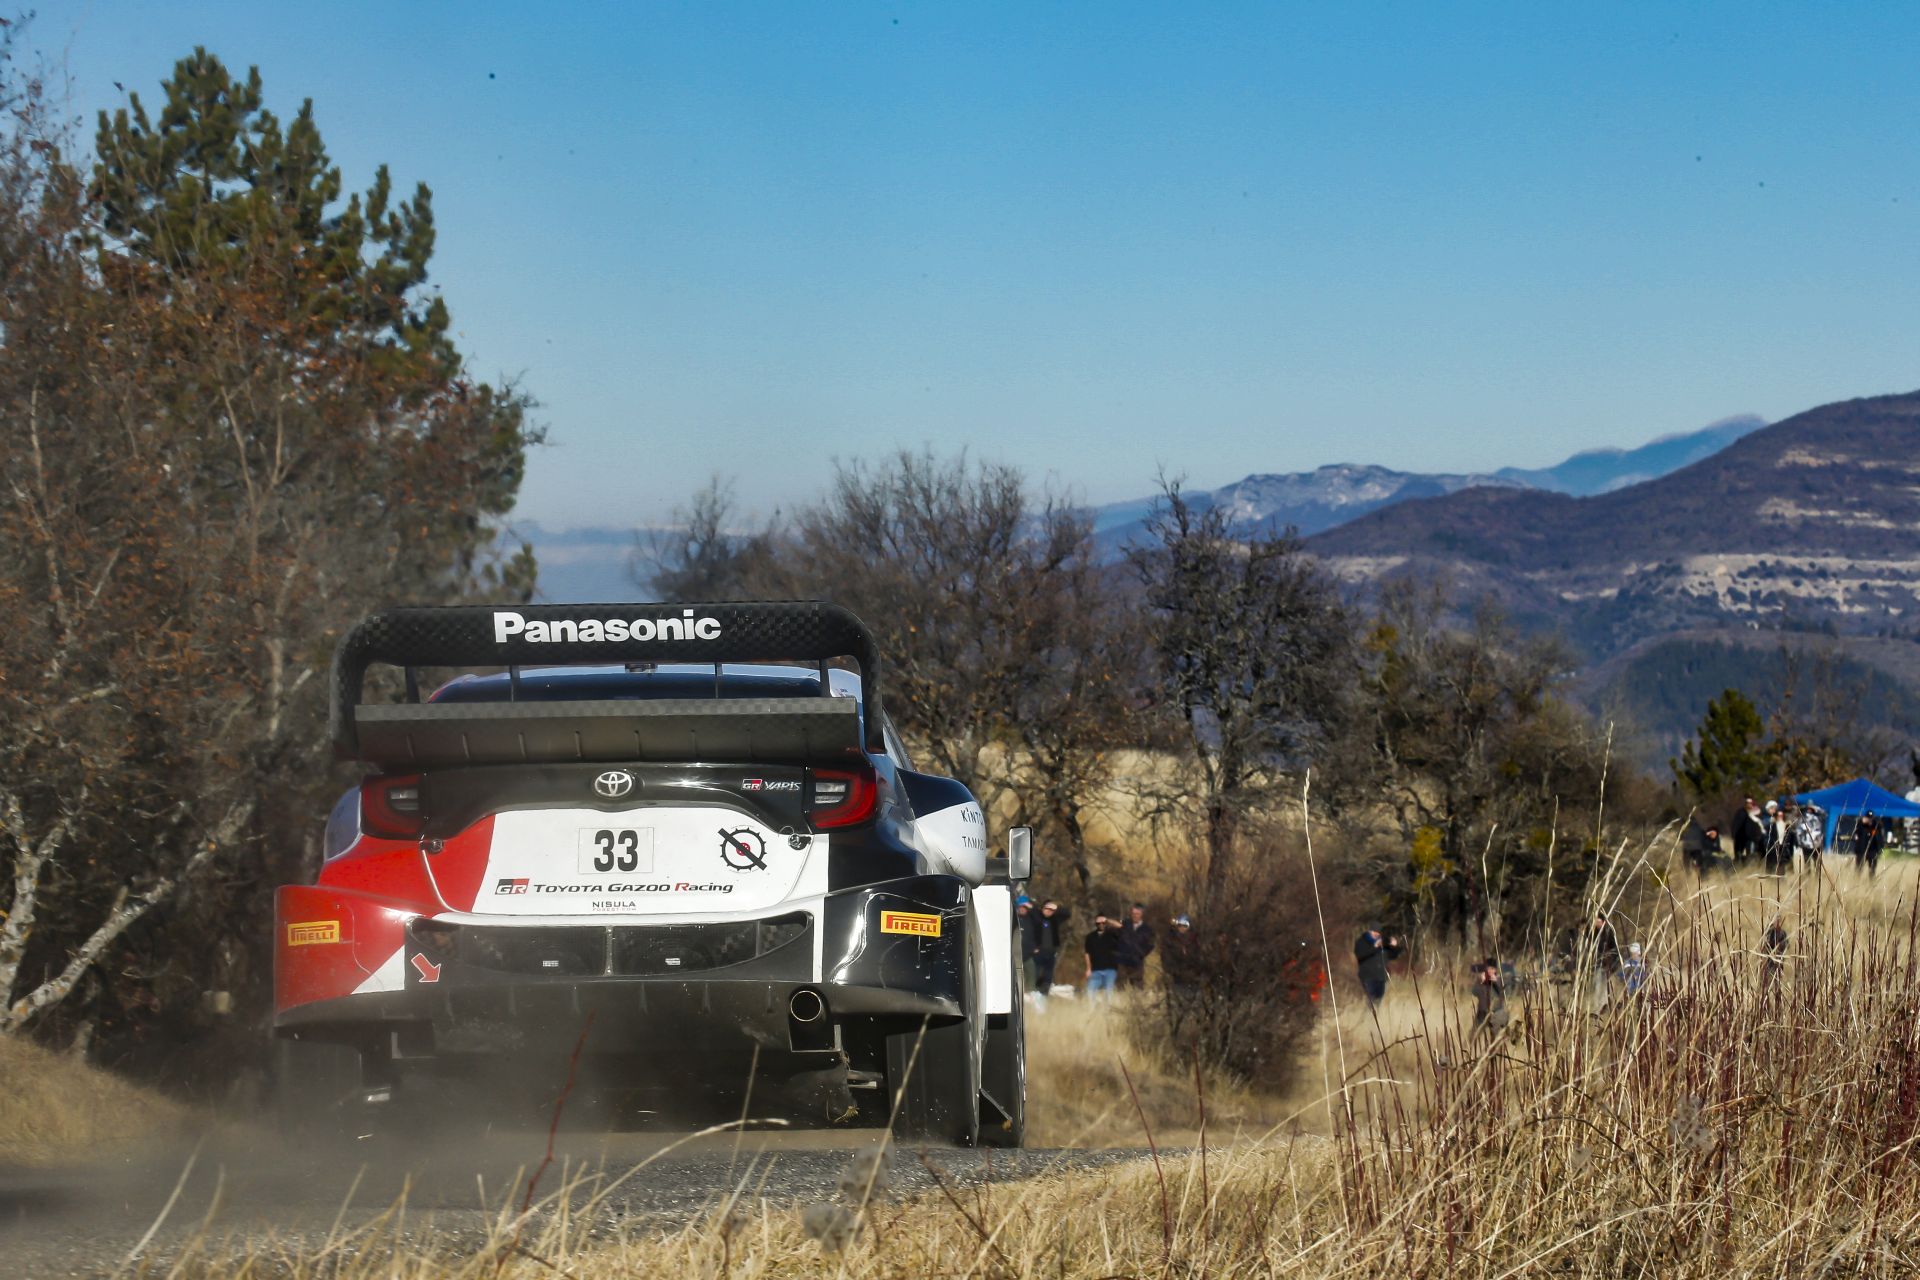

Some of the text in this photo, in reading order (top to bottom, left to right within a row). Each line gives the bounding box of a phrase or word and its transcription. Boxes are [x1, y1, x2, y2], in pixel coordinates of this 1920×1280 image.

[493, 609, 722, 643] Panasonic
[742, 782, 763, 791] GR
[593, 829, 639, 872] 33
[495, 882, 733, 895] GR TOYOTA GAZOO Racing
[886, 914, 938, 933] PIRELLI
[290, 924, 336, 942] PIRELLI
